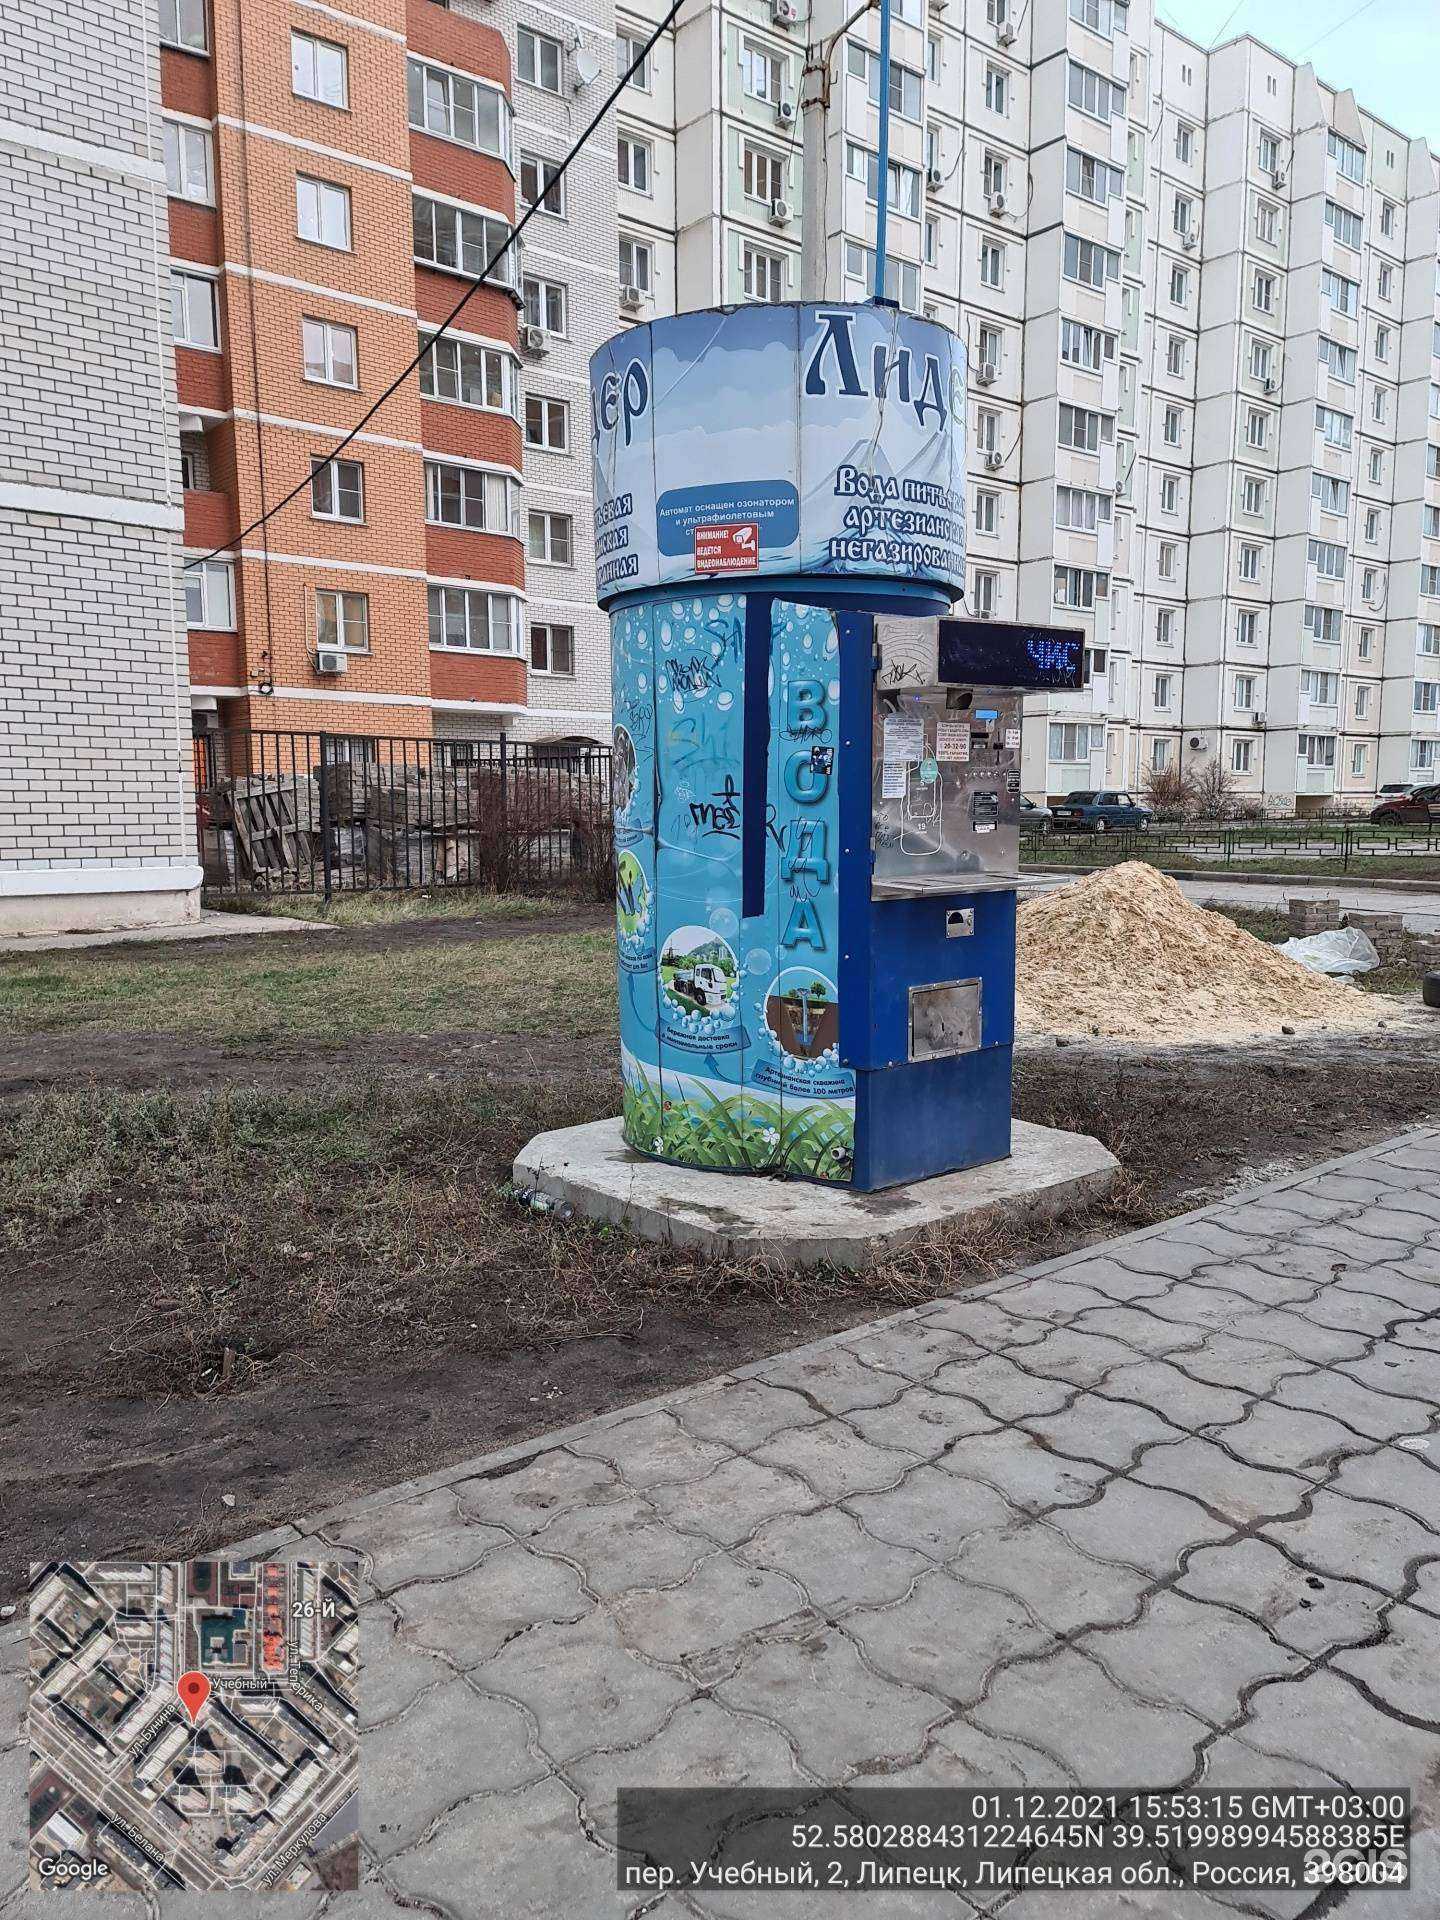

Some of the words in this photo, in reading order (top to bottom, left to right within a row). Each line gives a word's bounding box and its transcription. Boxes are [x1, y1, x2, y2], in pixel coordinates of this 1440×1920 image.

[834, 465, 899, 504] Вода
[660, 506, 692, 517] Автомат
[695, 502, 735, 512] оснащен
[737, 498, 795, 508] озонатором
[675, 518, 681, 526] и
[682, 510, 775, 527] ультрафиолетовым
[697, 529, 729, 540] ВНИМАНИЕ!
[697, 546, 722, 556] ВЕДЕТСЯ
[697, 556, 757, 569] ВИДЕОНАБЛЮДЕНИЕ
[715, 1041, 738, 1050] сроки
[789, 1082, 811, 1093] более
[827, 1086, 854, 1095] метров
[812, 1078, 846, 1086] скважина
